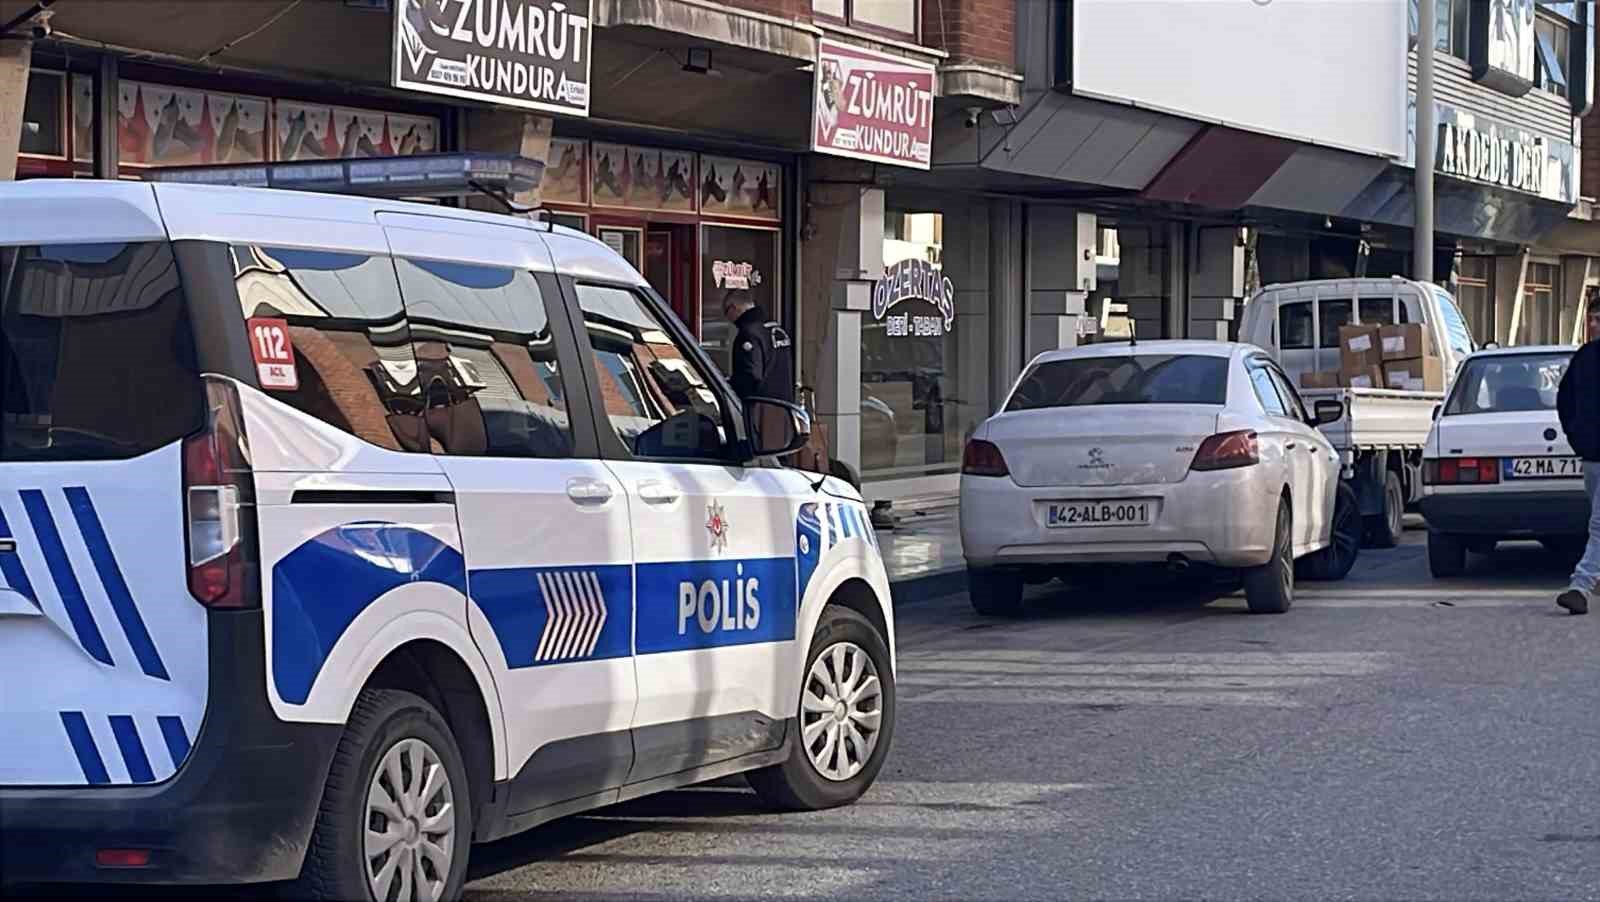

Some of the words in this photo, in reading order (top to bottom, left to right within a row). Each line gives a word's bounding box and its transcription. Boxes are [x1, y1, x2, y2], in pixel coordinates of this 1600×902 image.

[466, 53, 568, 102] KUNDURA
[855, 124, 917, 158] KUNDURA
[254, 326, 289, 359] 112
[1513, 458, 1531, 474] 42
[1536, 458, 1554, 474] MA
[678, 562, 760, 635] POLİS
